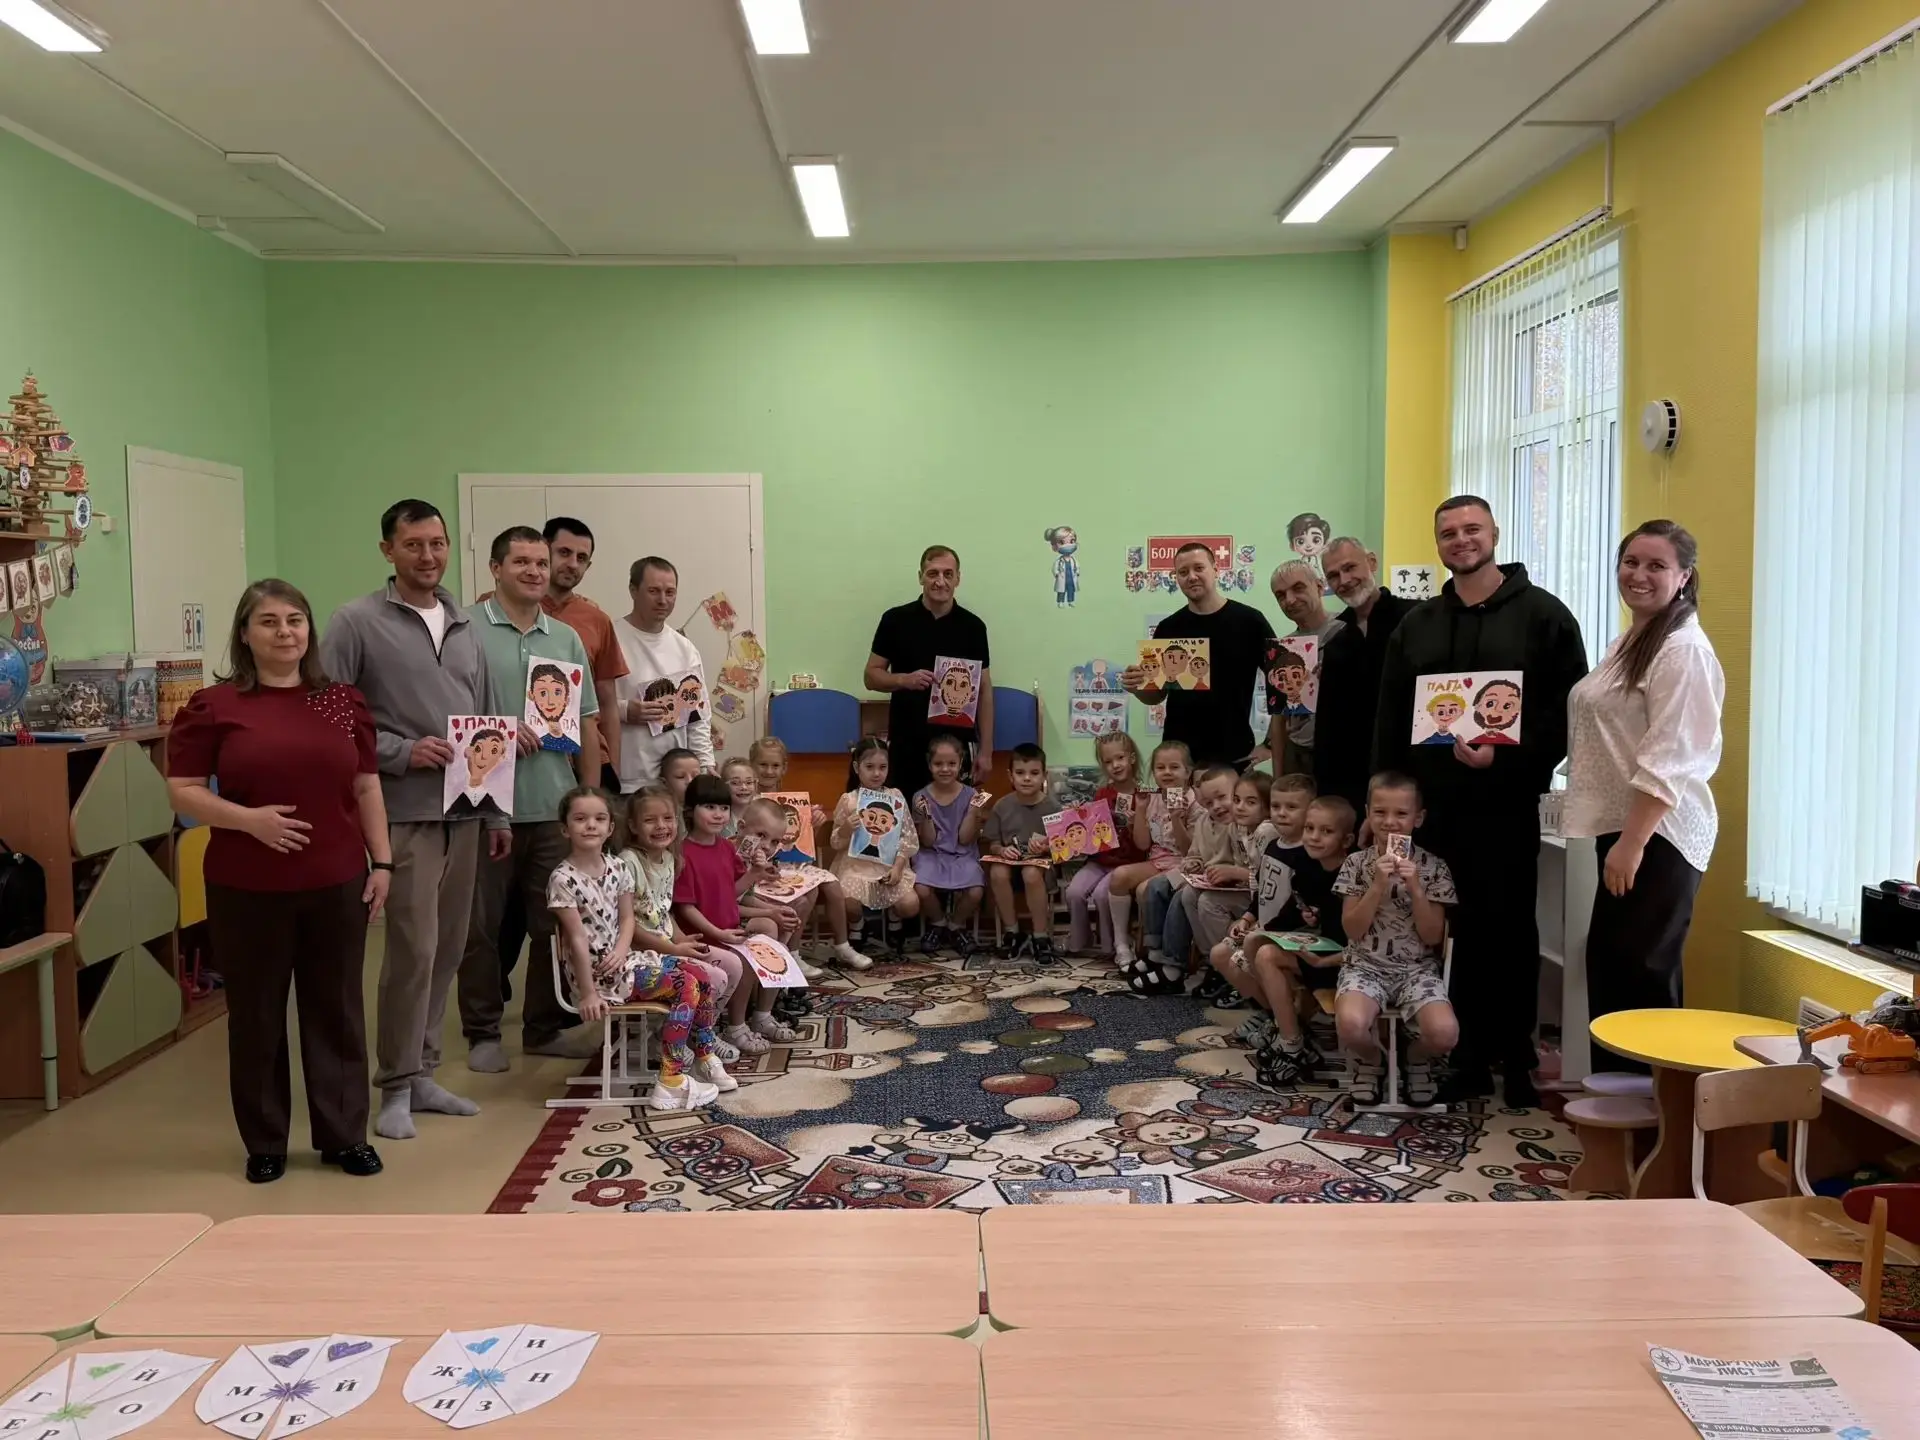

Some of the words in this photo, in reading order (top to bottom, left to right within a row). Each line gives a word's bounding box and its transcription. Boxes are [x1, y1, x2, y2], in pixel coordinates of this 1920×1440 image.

[1427, 680, 1462, 692] ПАПА
[464, 717, 507, 730] ПАПА
[1716, 1367, 1756, 1376] ЛИСТ
